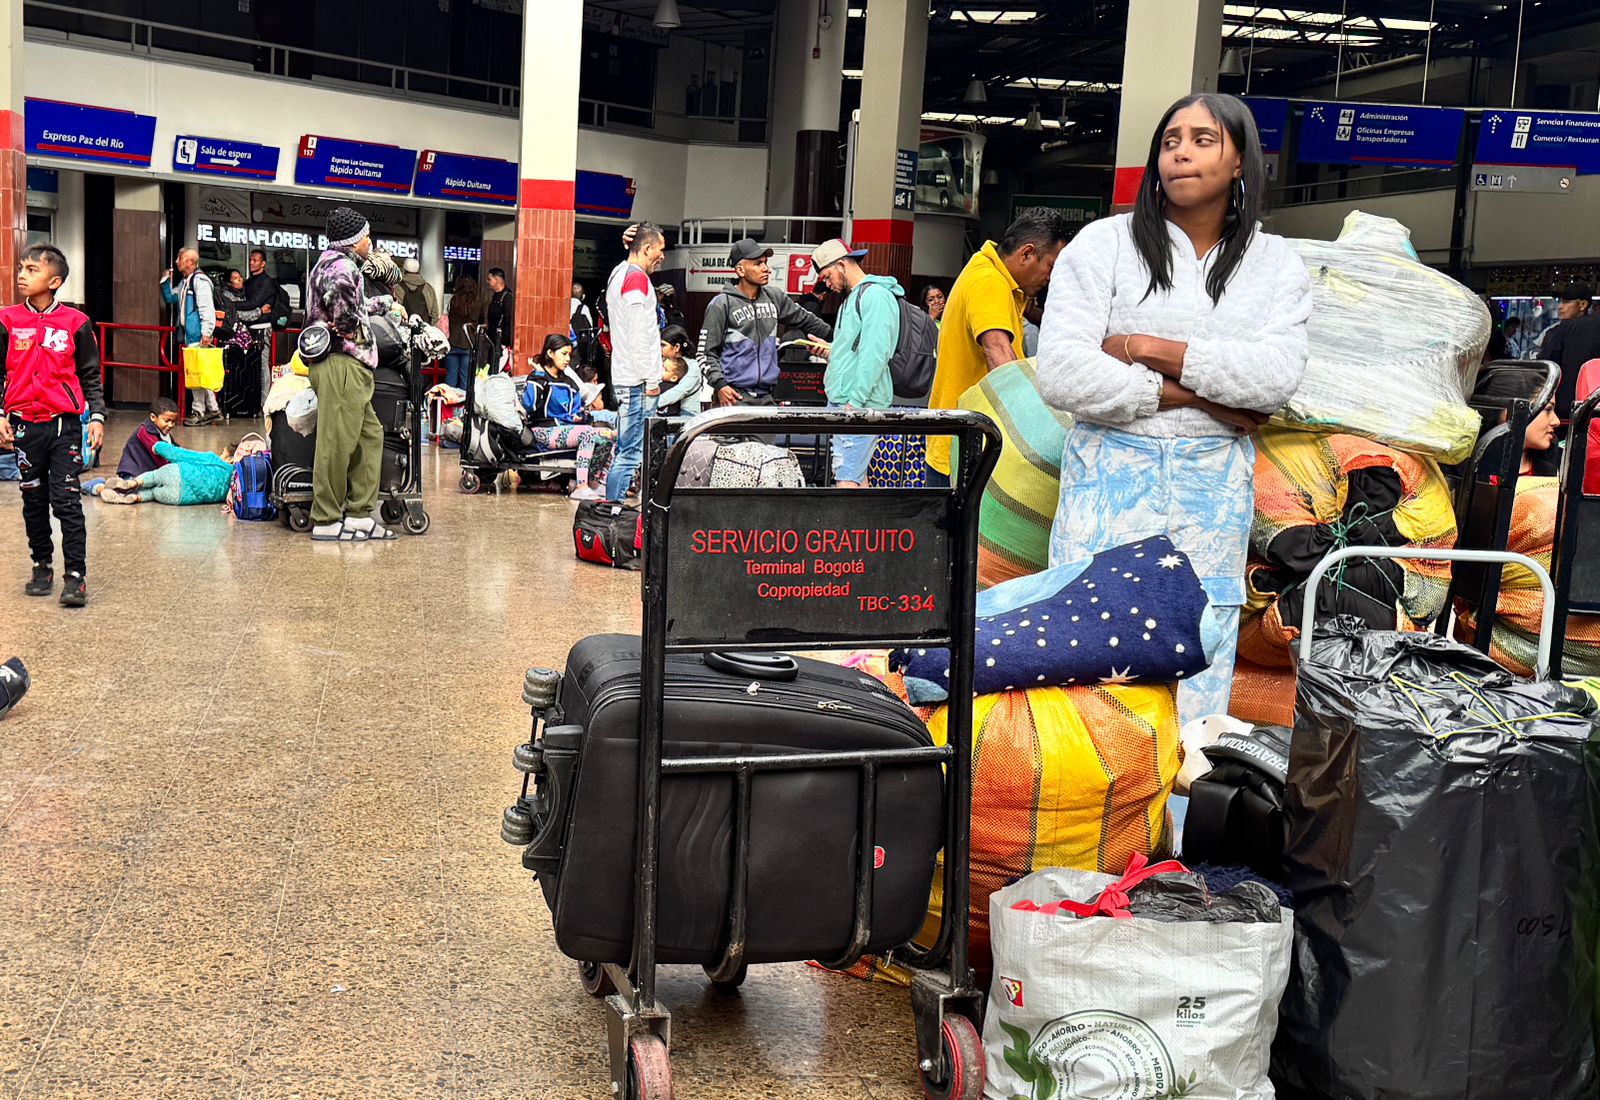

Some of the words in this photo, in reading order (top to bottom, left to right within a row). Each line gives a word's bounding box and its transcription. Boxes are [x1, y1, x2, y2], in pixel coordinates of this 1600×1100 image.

[1360, 112, 1408, 121] Administración
[42, 130, 78, 143] Expreso
[78, 134, 94, 145] Paz
[95, 136, 109, 147] del
[1356, 135, 1407, 143] Transportadoras
[1384, 128, 1415, 136] Empresas
[1533, 134, 1563, 143] Comercio
[200, 145, 215, 156] Sala
[216, 147, 227, 156] de
[228, 151, 252, 160] espera
[303, 148, 314, 156] 157
[354, 167, 382, 178] Duitama
[702, 258, 716, 267] SALA
[717, 258, 726, 267] DE
[691, 529, 799, 554] SERVICIO
[805, 529, 916, 553] GRATUITO
[743, 560, 806, 575] Terminal
[814, 559, 865, 577] Bogotá
[757, 583, 851, 600] Copropiedad
[857, 594, 935, 612] TBC-334
[1177, 995, 1206, 1010] 25
[1176, 1008, 1206, 1019] kilos
[1110, 1029, 1141, 1055] AHORRO
[1051, 1023, 1086, 1041] AHORRO
[1094, 1021, 1151, 1051] NATURALEZA
[1151, 1057, 1164, 1089] MEDIO
[1125, 1053, 1136, 1067] ECO
